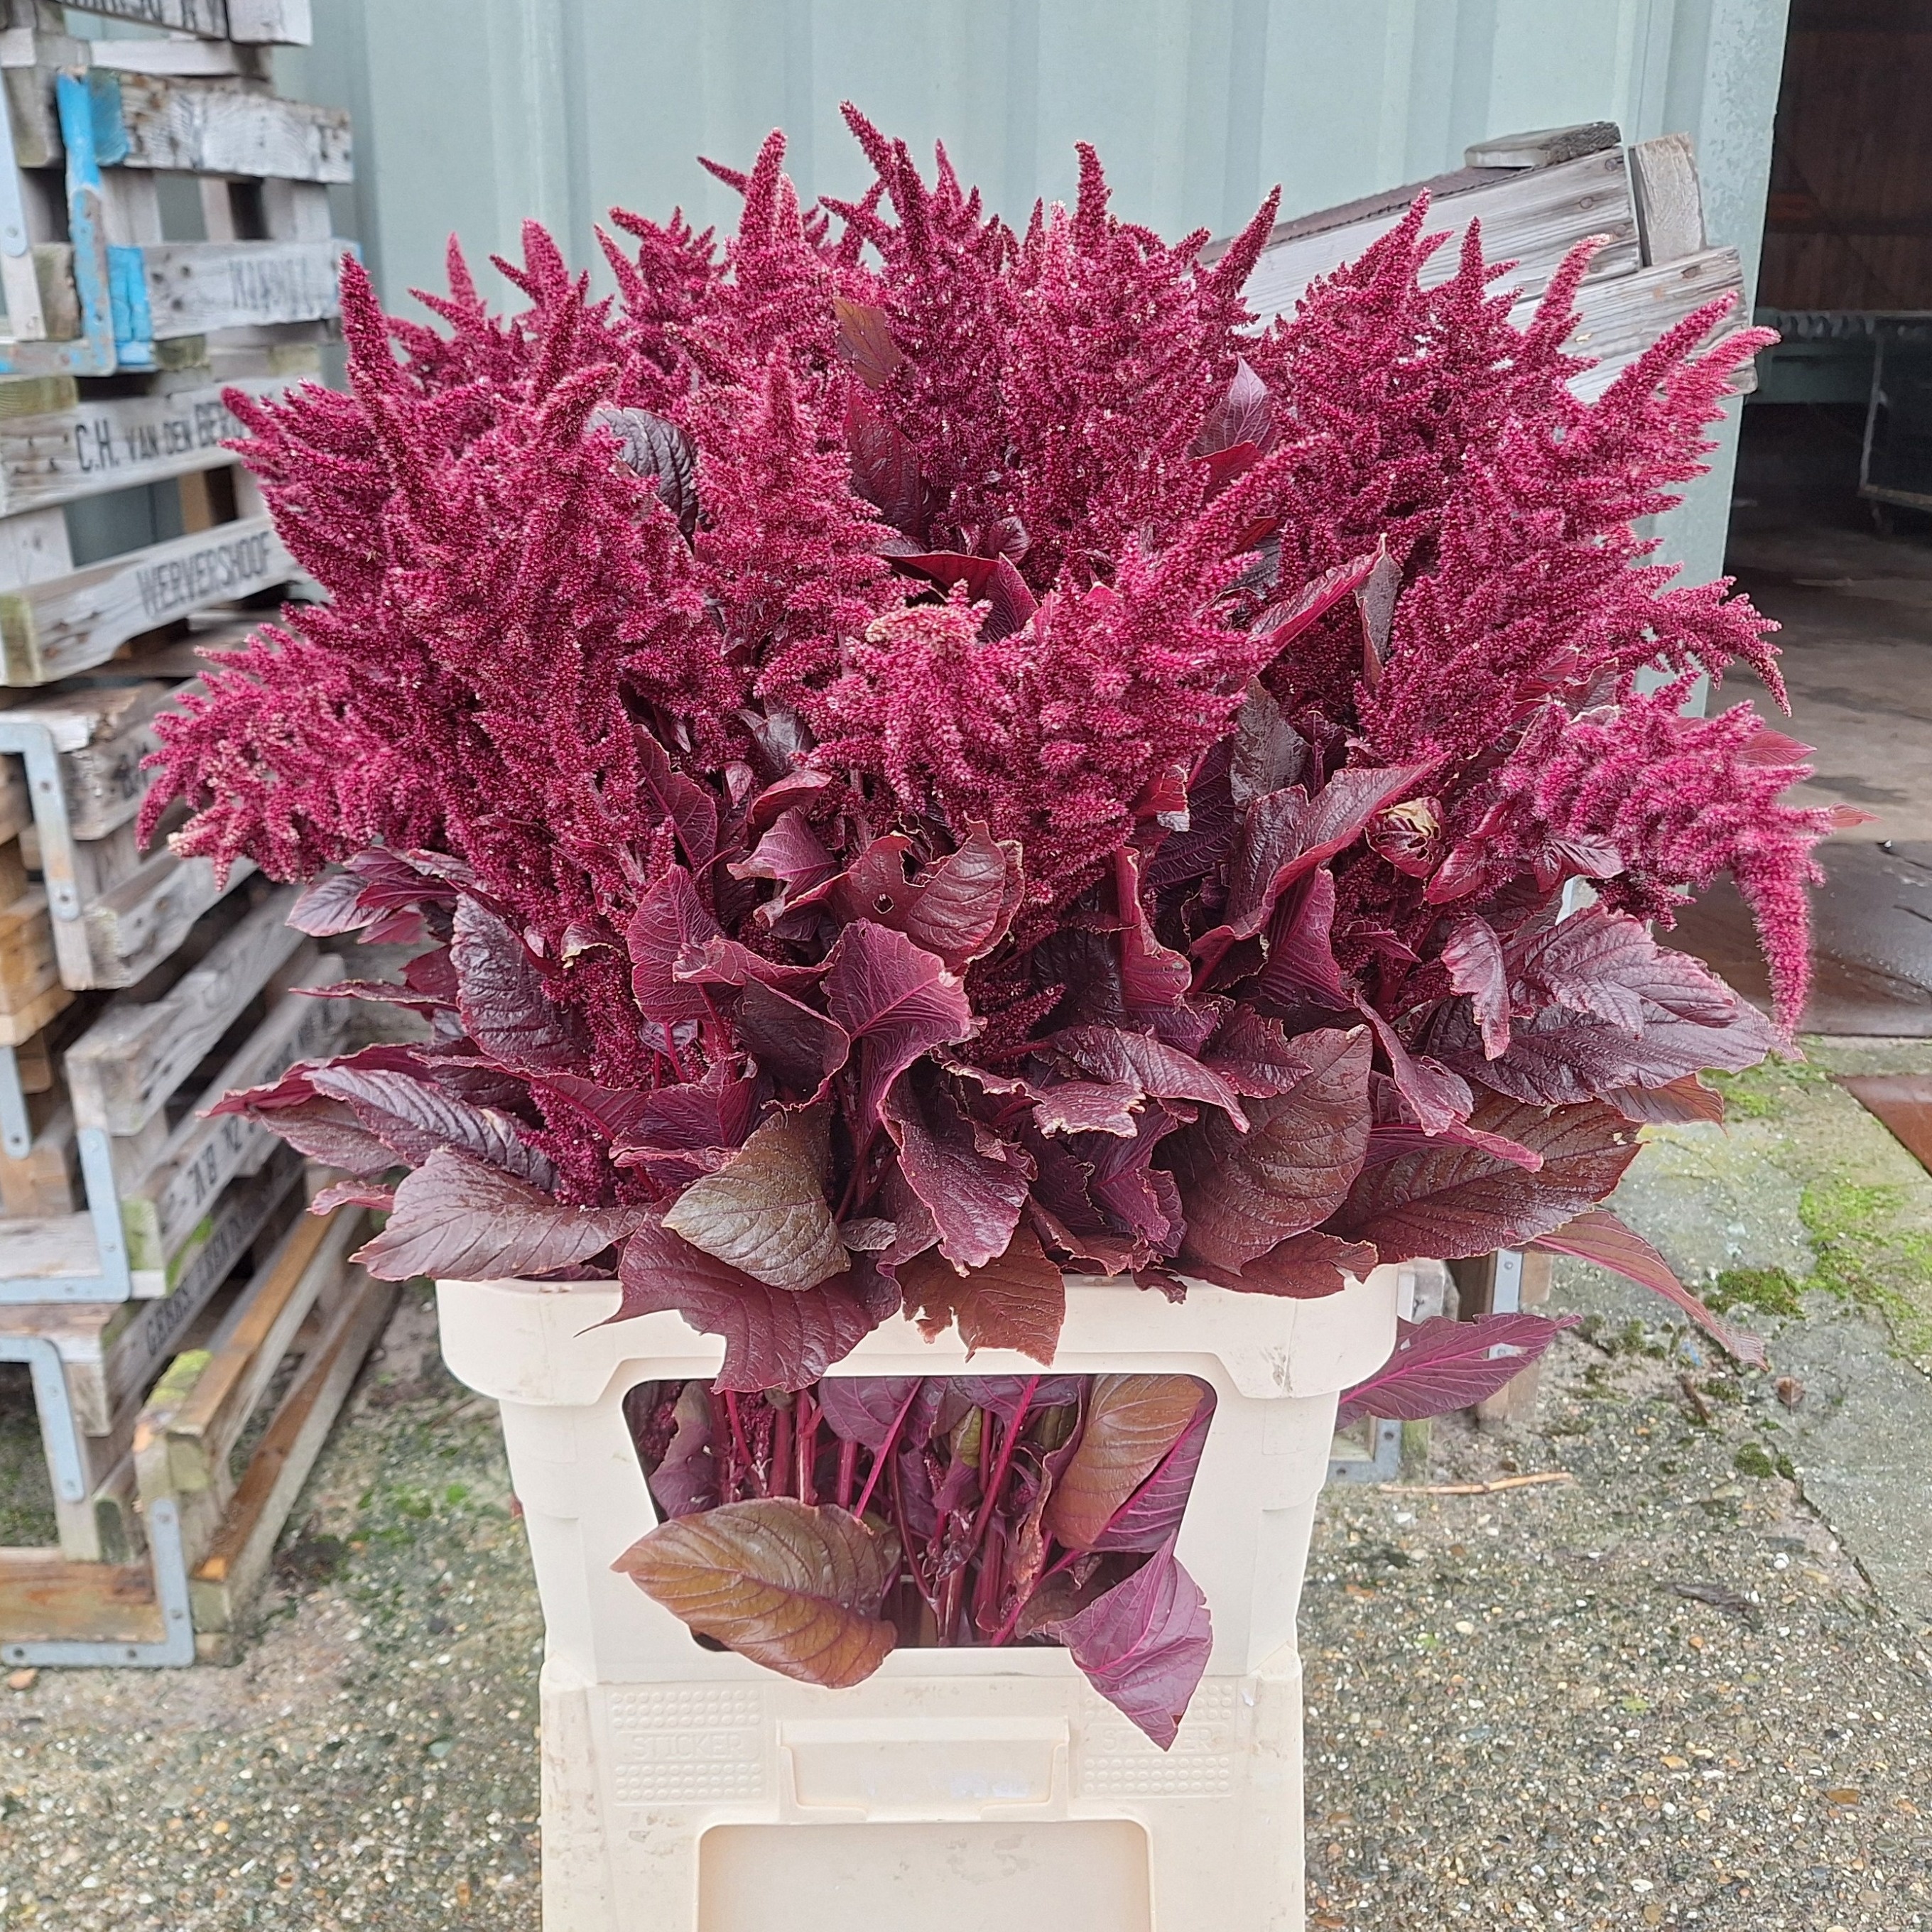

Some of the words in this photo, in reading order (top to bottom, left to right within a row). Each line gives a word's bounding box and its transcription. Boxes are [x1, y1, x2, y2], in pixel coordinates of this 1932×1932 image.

[75, 417, 120, 472] C.H.
[124, 425, 159, 462] VAN
[631, 1732, 743, 1760] STICKER
